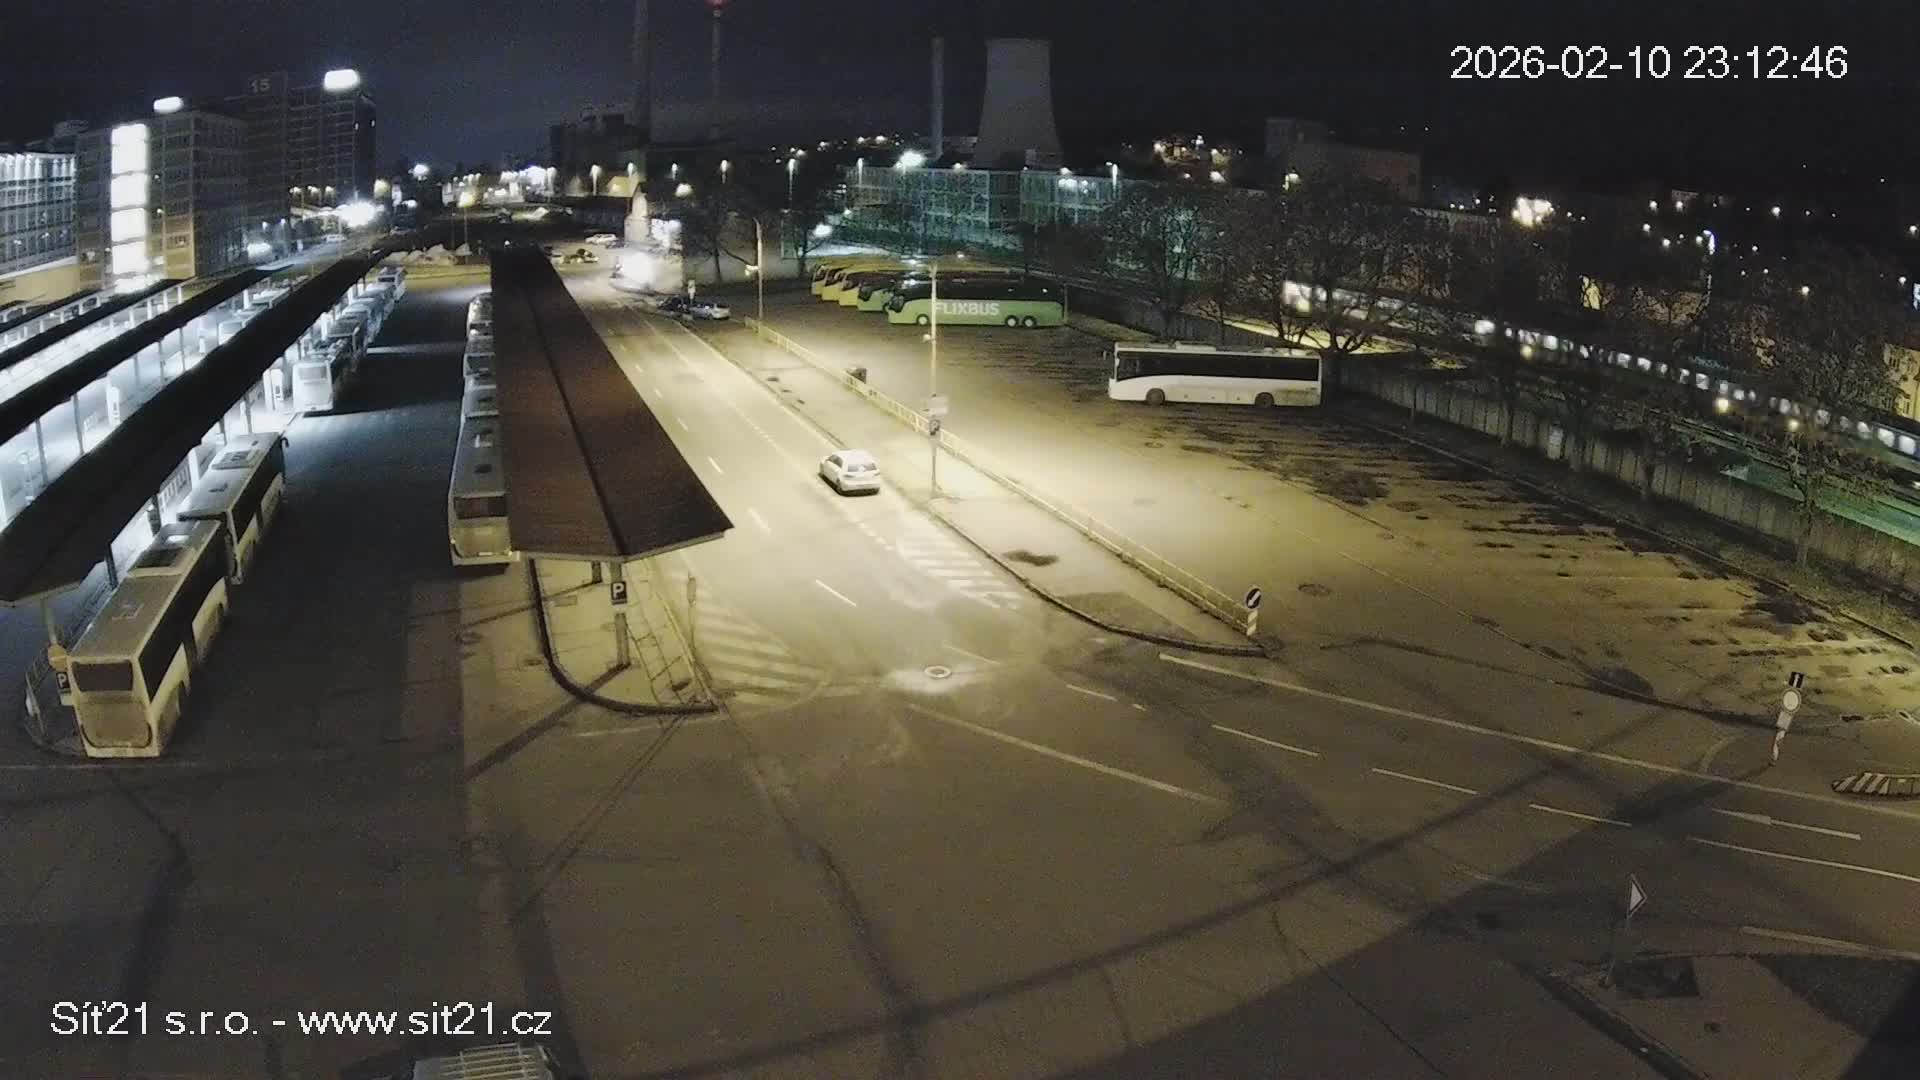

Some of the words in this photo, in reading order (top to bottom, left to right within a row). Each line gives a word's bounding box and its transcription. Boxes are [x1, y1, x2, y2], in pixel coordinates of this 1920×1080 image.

[250, 78, 271, 93] 15
[935, 302, 1001, 316] FLIXBUS
[613, 582, 625, 600] P
[57, 673, 68, 688] P
